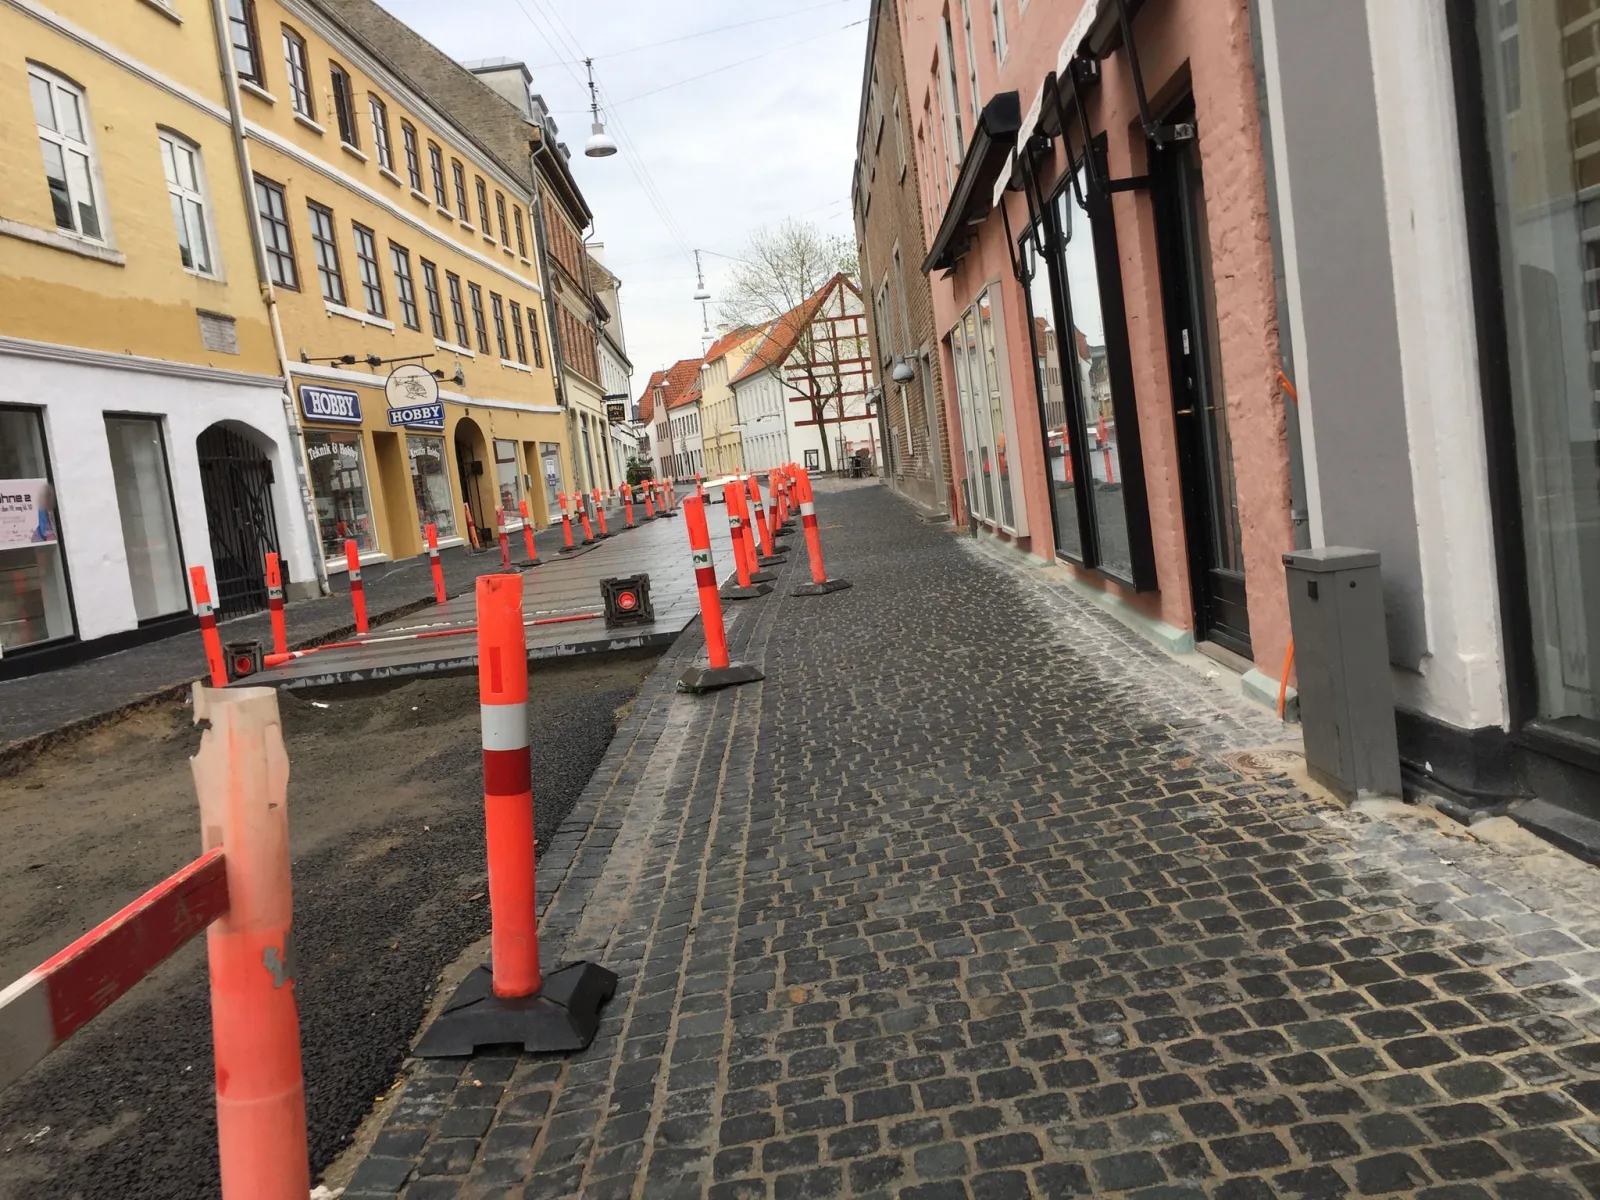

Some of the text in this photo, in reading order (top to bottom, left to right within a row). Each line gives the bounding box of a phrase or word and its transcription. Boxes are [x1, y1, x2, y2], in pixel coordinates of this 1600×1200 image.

[310, 392, 354, 416] HOBBY
[391, 405, 440, 423] HOBBY
[307, 442, 359, 461] Teknik & Hobby
